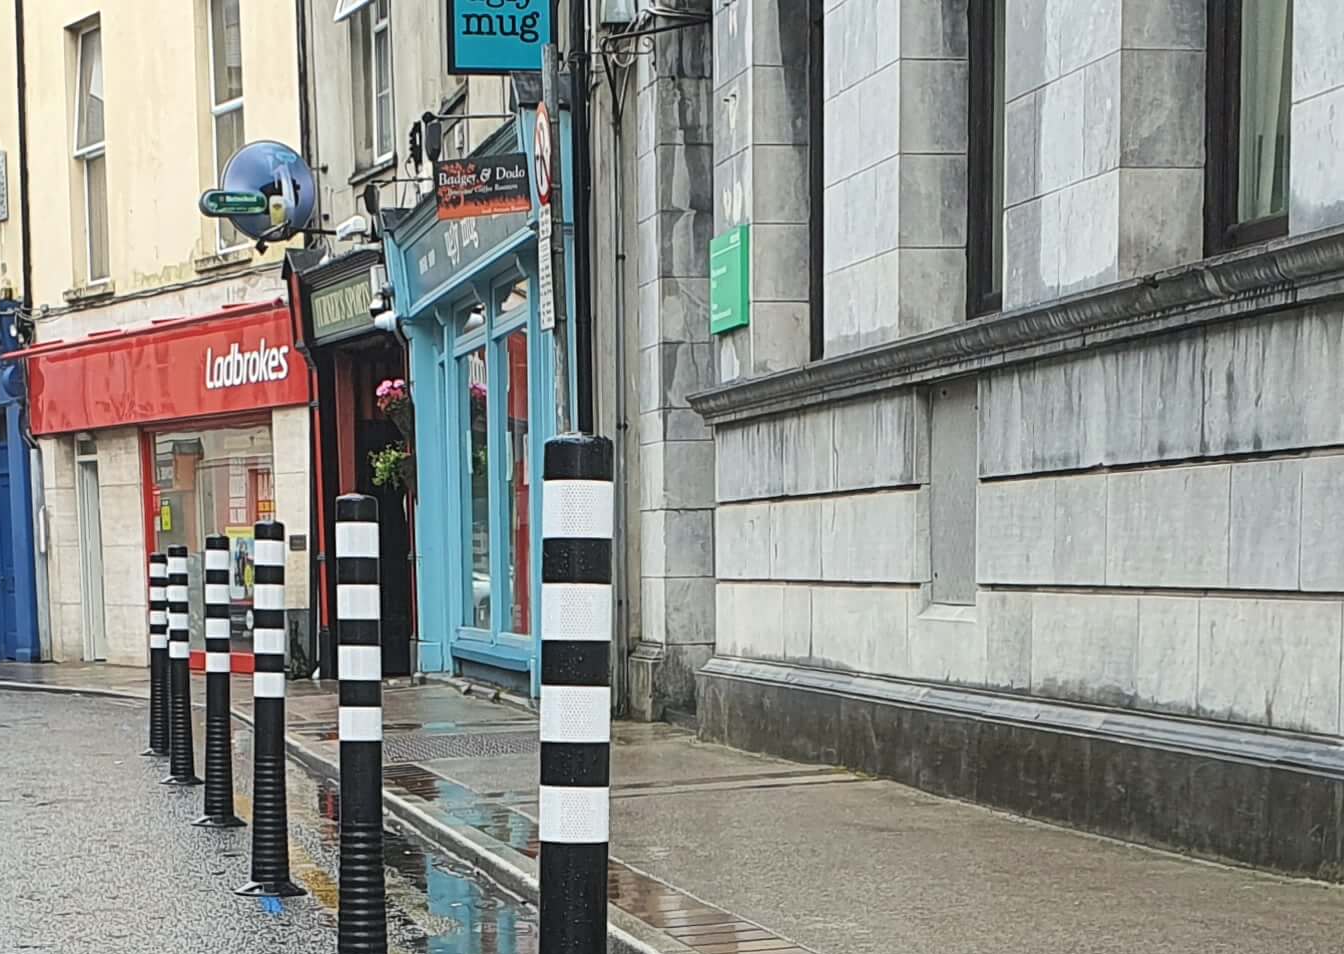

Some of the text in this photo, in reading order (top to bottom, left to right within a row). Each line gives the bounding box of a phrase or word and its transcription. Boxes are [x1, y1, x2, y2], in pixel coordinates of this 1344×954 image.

[462, 11, 540, 43] mug
[439, 170, 477, 186] Badger
[496, 164, 525, 180] Dodo
[205, 337, 289, 389] Ladbrokes
